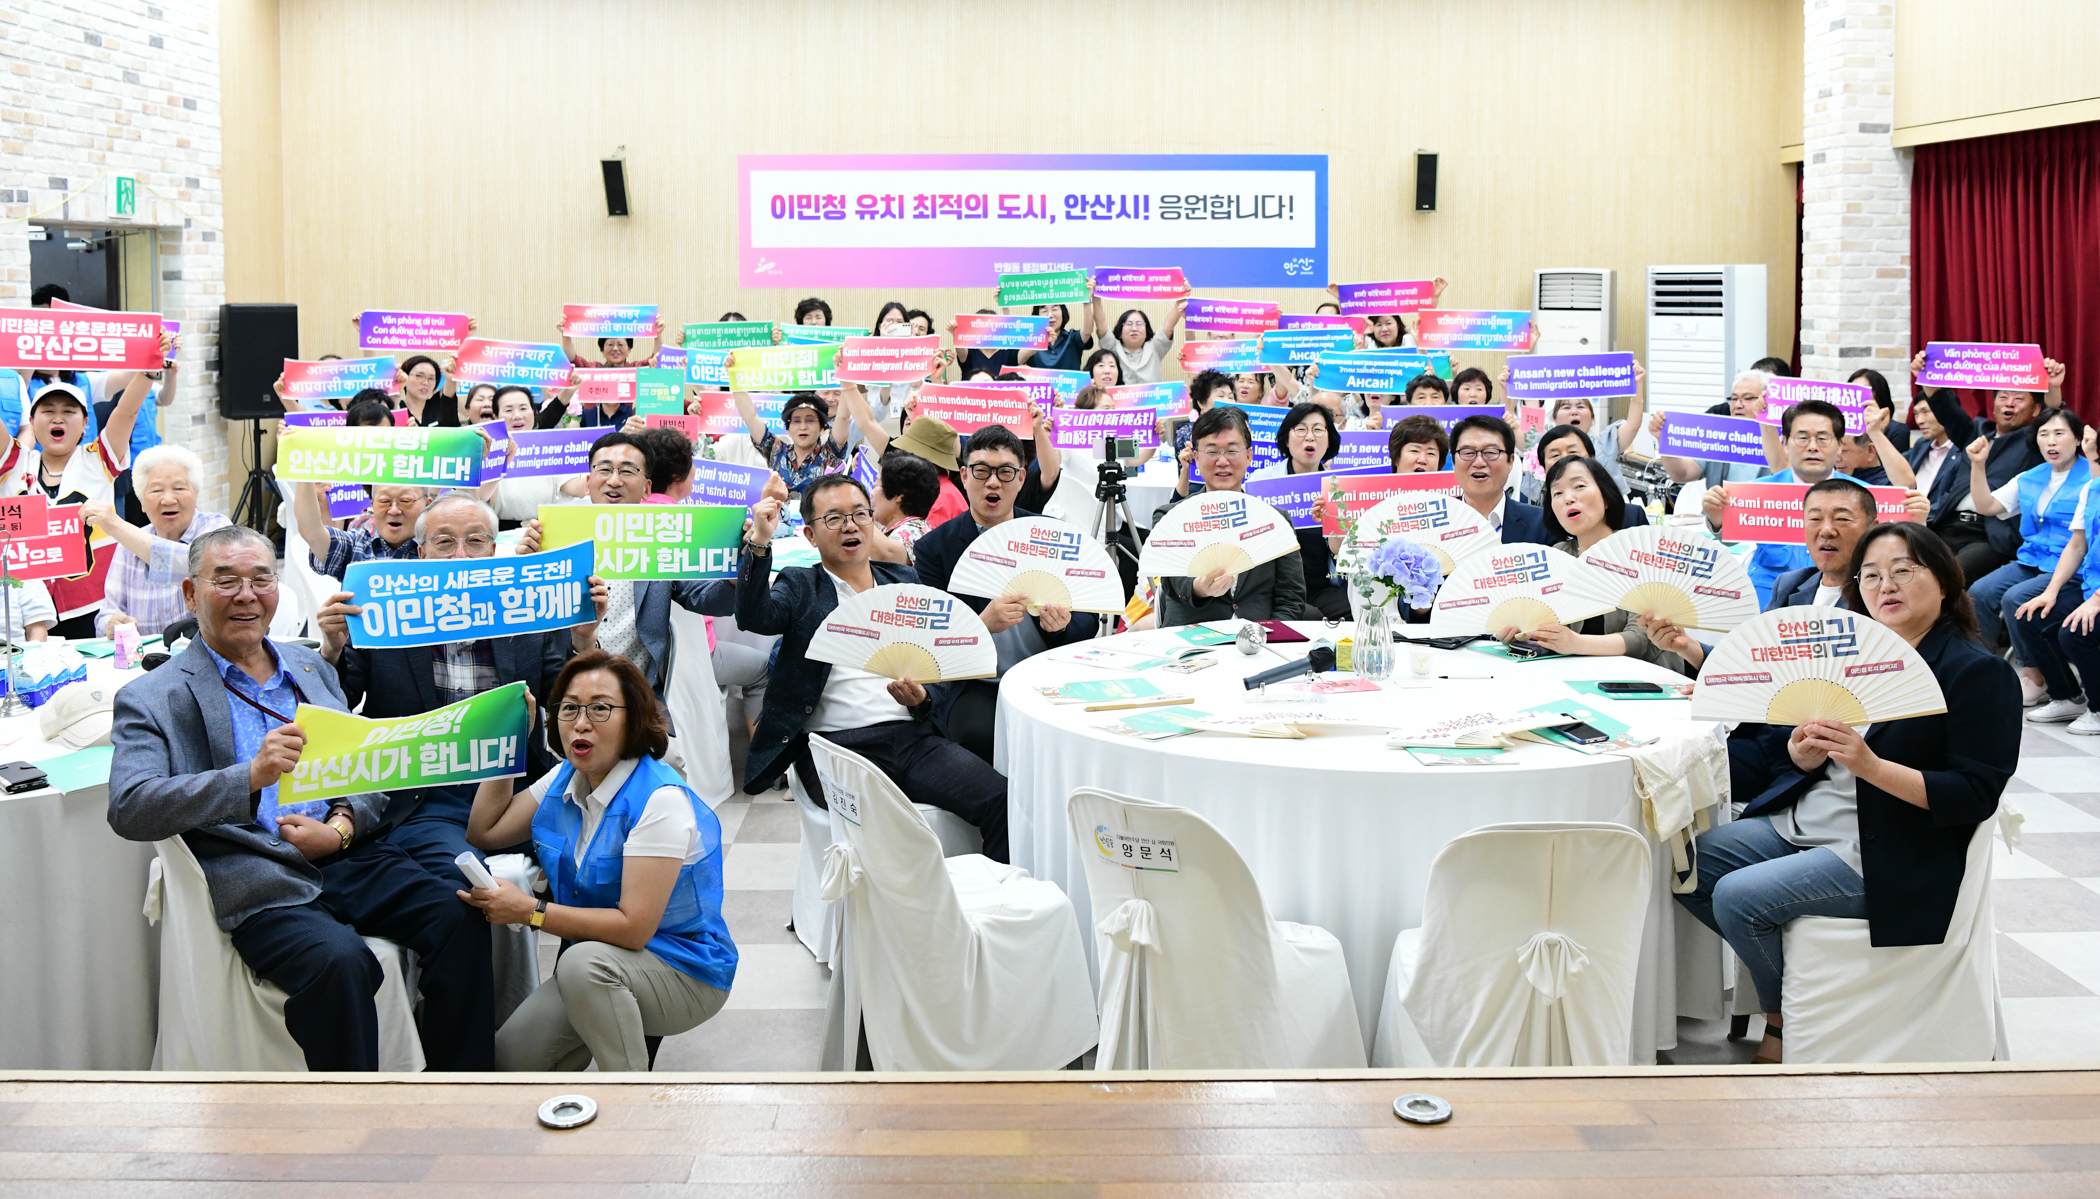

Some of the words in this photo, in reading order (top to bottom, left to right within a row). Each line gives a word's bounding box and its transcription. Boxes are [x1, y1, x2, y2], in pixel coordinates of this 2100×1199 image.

[771, 194, 847, 220] 이민청
[855, 194, 904, 220] 유치
[913, 194, 988, 220] 최적의
[997, 194, 1056, 224] 도시,
[1064, 194, 1150, 220] 안산시!
[1158, 194, 1294, 220] 응원합니다!
[994, 262, 1020, 273] 반월동
[59, 320, 153, 338] 상호문화도시
[397, 316, 422, 327] phòng
[373, 326, 388, 334] Con
[429, 328, 455, 336] Ansan!
[17, 335, 126, 362] 안산으로
[366, 336, 382, 345] Con
[695, 354, 722, 365] 안산의
[761, 349, 818, 369] 이민청!
[843, 347, 860, 357] Kami
[861, 347, 899, 359] mendukung
[900, 348, 934, 359] pendirian
[1961, 350, 1991, 361] phòng
[2001, 350, 2019, 359] trú!
[847, 361, 870, 371] Kantor
[872, 361, 902, 373] Imigrant
[904, 361, 928, 371] Korea!
[1513, 368, 1552, 379] Ansan's
[1554, 369, 1572, 378] new
[1574, 365, 1631, 380] challenge!
[1934, 361, 1952, 370] Con
[2000, 363, 2032, 372] Ansan!
[736, 370, 794, 388] 안산시가
[1346, 376, 1394, 389] Ансан!
[1514, 381, 1528, 390] The
[1529, 379, 1576, 392] Immigration
[1577, 378, 1631, 392] Department!
[1926, 372, 1944, 381] Con
[1991, 372, 2010, 383] Hàn
[917, 394, 937, 404] Kami
[939, 395, 987, 409] mendukung
[988, 400, 1028, 412] pendirian
[923, 408, 952, 420] Kantor
[953, 410, 990, 425] Imigrant
[992, 413, 1021, 425] Korea!
[1058, 412, 1154, 426] 安山的新挑战!
[336, 427, 429, 450] 이민청!
[1668, 423, 1704, 438] Ansan's
[1705, 429, 1725, 441] new
[542, 445, 562, 454] new
[1359, 444, 1377, 454] new
[1668, 437, 1681, 447] The
[1683, 438, 1729, 454] Immigration
[289, 450, 386, 477] 안산시가
[393, 454, 471, 481] 합니다!
[516, 457, 564, 469] Immigration
[1334, 455, 1381, 467] Immigration
[1729, 496, 1760, 509] Kami
[1200, 502, 1228, 516] 안산의
[1229, 498, 1248, 528] 길
[1397, 502, 1428, 516] 안산의
[1428, 498, 1449, 528] 길
[1739, 513, 1784, 528] Kantor
[595, 513, 692, 543] 이민청!
[1183, 518, 1230, 533] 대한민국의
[1007, 540, 1058, 560] 대한민국의
[1030, 526, 1062, 543] 안산의
[1062, 532, 1082, 561] 길
[0, 541, 63, 571] 산으로
[657, 547, 737, 573] 합니다!
[1630, 549, 1690, 574] 대한민국의
[1657, 537, 1694, 557] 안산의
[1691, 547, 1718, 579] 길
[1491, 555, 1526, 570] 안산의
[1526, 550, 1550, 582] 길
[368, 573, 439, 598] 안산의
[443, 567, 514, 589] 새로운
[520, 558, 572, 583] 도전!
[1473, 572, 1528, 590] 대한민국의
[362, 591, 496, 637] 이민청과
[500, 581, 581, 625] 함께!
[895, 593, 931, 611] 안산의
[929, 598, 953, 630] 길
[870, 610, 927, 629] 대한민국의
[1777, 620, 1825, 638] 안산의
[1826, 616, 1859, 658] 길
[1751, 642, 1828, 662] 대한민국의
[359, 703, 472, 748] 이민청!
[292, 745, 411, 793] 안산시가
[420, 735, 517, 777] 합니다!
[1122, 843, 1172, 862] 양문석
